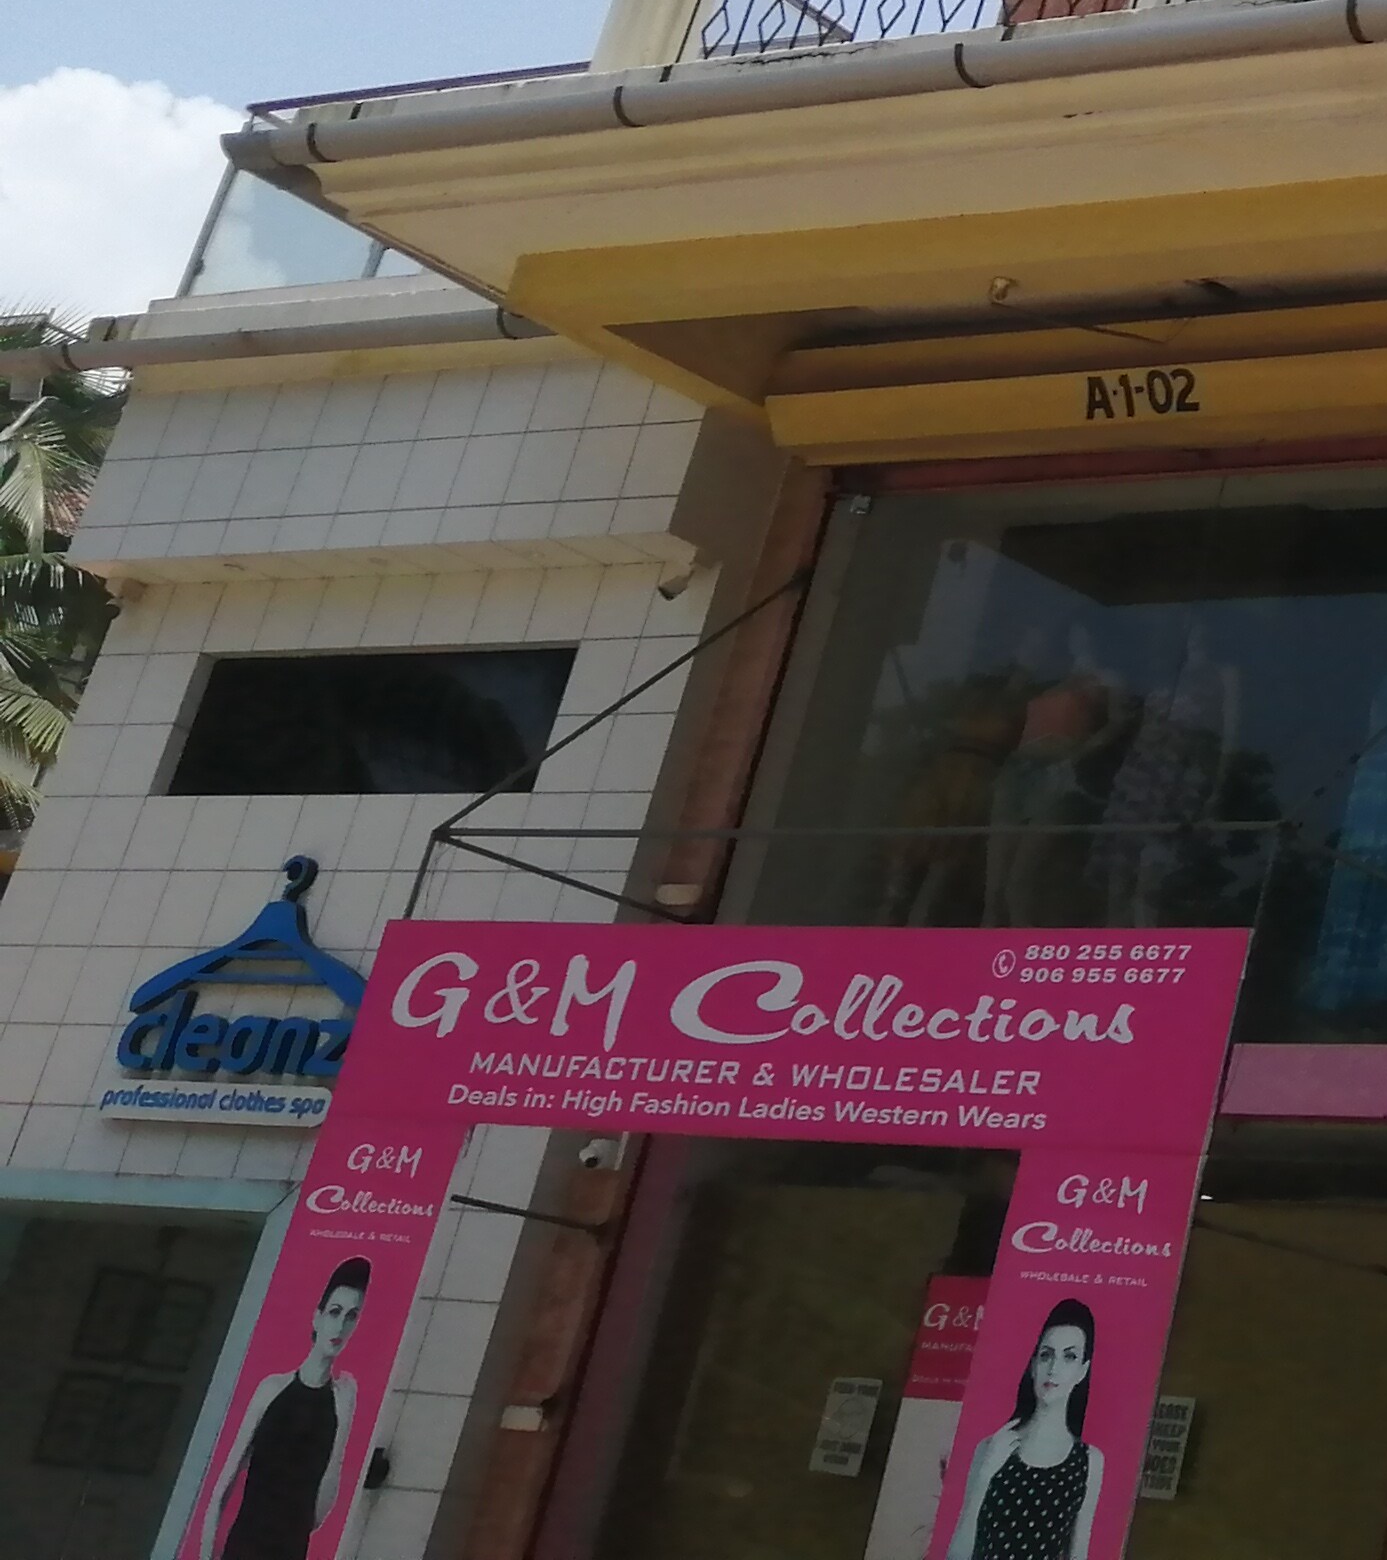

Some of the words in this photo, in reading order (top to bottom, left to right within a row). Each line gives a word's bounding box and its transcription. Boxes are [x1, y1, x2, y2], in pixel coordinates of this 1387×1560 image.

[1024, 945, 1071, 960] 880
[1076, 945, 1122, 960] 255
[1129, 945, 1192, 960] 6677
[1019, 968, 1065, 983] 906
[1071, 968, 1117, 983] 955
[1123, 968, 1186, 984] 6677
[391, 951, 637, 1052] G&M
[670, 960, 1135, 1044] Collections
[469, 1051, 741, 1085] MANUFACTURER
[752, 1063, 775, 1086] &
[791, 1063, 1042, 1095] WHOLESALER
[99, 1084, 218, 1111] professional
[218, 1090, 286, 1114] clothes
[288, 1096, 327, 1120] spa
[448, 1083, 518, 1108] Deals
[523, 1087, 554, 1109] in:
[561, 1089, 623, 1117] High
[630, 1091, 731, 1117] Fashion
[738, 1096, 826, 1121] Ladies
[834, 1100, 948, 1126] Western
[957, 1105, 1047, 1130] Wears
[347, 1143, 423, 1179] G&M
[306, 1184, 434, 1217] Collections
[1057, 1174, 1149, 1215] G&M
[1011, 1221, 1172, 1258] Collections
[1020, 1271, 1090, 1284] WHOLESALE
[1094, 1273, 1104, 1285] &
[1108, 1275, 1148, 1288] RETAIL
